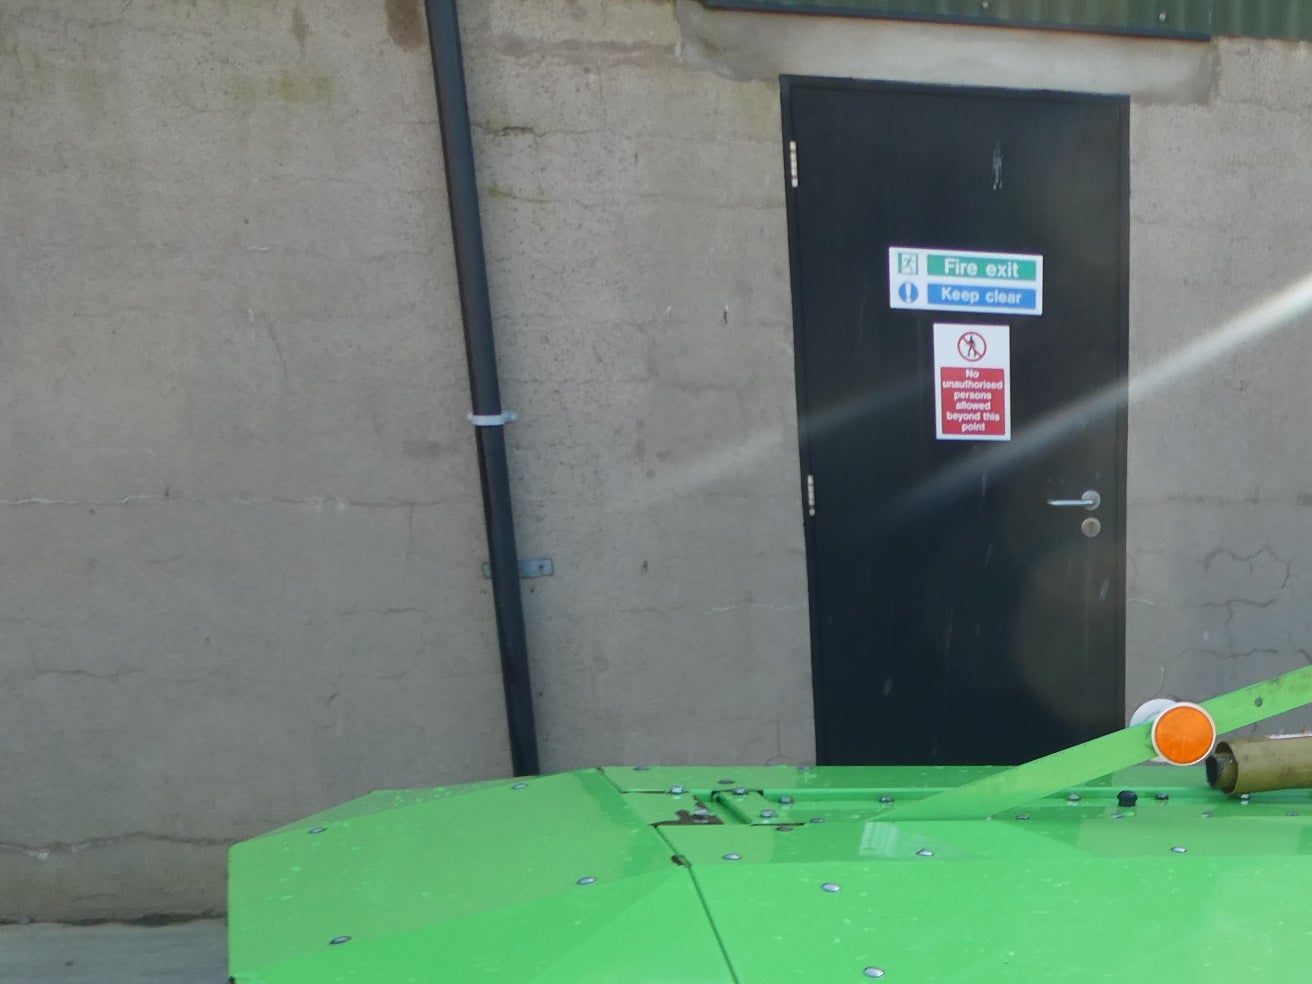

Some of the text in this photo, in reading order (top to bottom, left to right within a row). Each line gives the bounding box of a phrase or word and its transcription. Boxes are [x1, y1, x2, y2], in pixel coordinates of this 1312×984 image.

[944, 257, 1020, 278] Fire exit
[941, 288, 1022, 305] Keep clear
[965, 369, 979, 378] No
[942, 379, 1003, 389] unauthorised
[953, 391, 992, 400] persons
[955, 401, 991, 411] allowed
[946, 412, 1000, 422] beyond this
[961, 422, 986, 433] point
